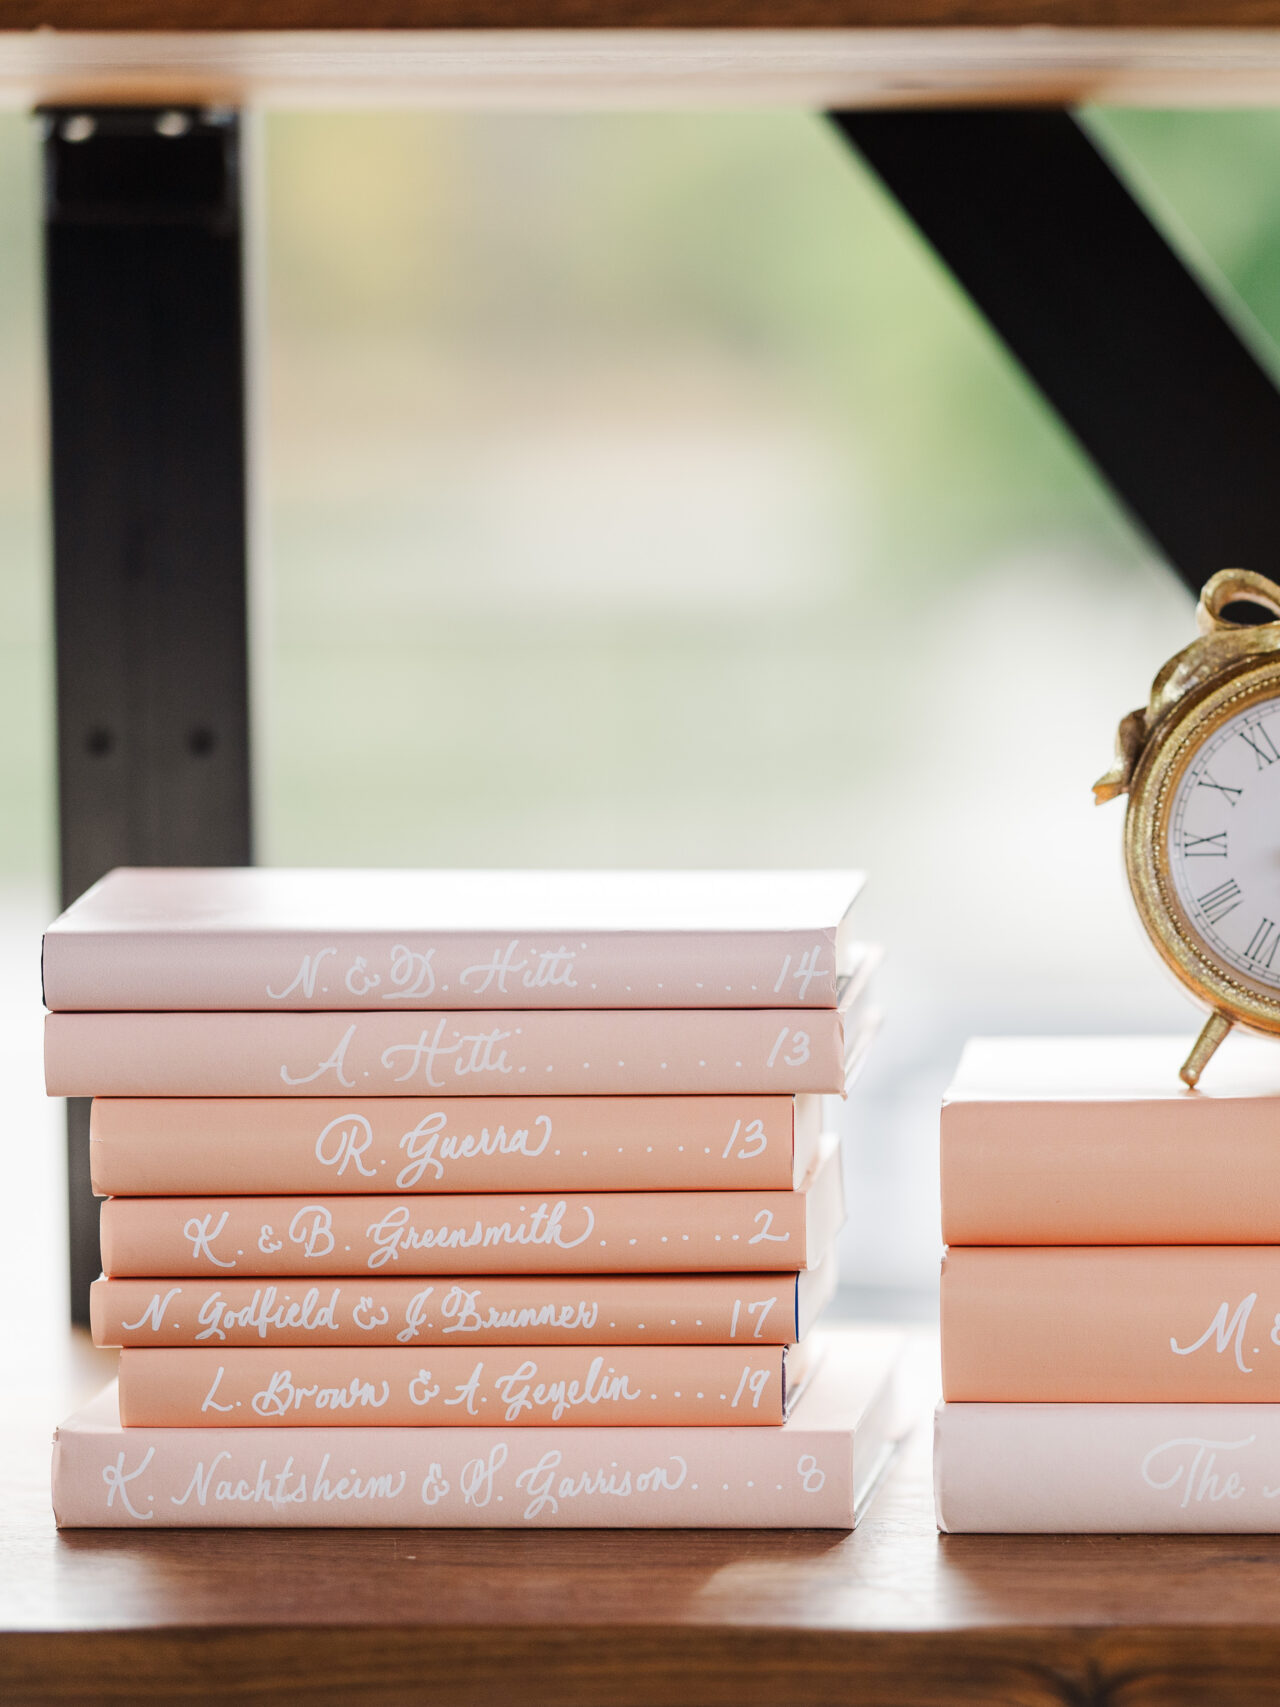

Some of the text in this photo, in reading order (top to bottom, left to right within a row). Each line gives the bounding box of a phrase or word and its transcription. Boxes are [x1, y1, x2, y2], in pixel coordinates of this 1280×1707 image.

[1197, 769, 1243, 807] X
[1183, 831, 1228, 857] IX
[1197, 878, 1244, 925] VIII
[346, 956, 380, 995] &
[460, 940, 587, 993] Hitti
[774, 945, 829, 999] 14
[280, 1018, 810, 1087] A. Hitti 13
[396, 1112, 552, 1188] Guerra
[722, 1119, 767, 1158] 13
[258, 1225, 282, 1253] &
[367, 1201, 594, 1268] Greensmith
[749, 1209, 790, 1244] 2
[195, 1286, 340, 1340] Godfield
[353, 1296, 388, 1330] &
[441, 1286, 597, 1333] Brunner
[730, 1297, 777, 1337] 17
[252, 1370, 389, 1416] Brown
[409, 1369, 440, 1406] &
[731, 1366, 770, 1408] 19
[171, 1450, 406, 1506] Nachtsheim
[422, 1463, 450, 1505] &
[515, 1450, 687, 1520] Garrison
[797, 1454, 825, 1491] 8
[1141, 1434, 1256, 1507] The
